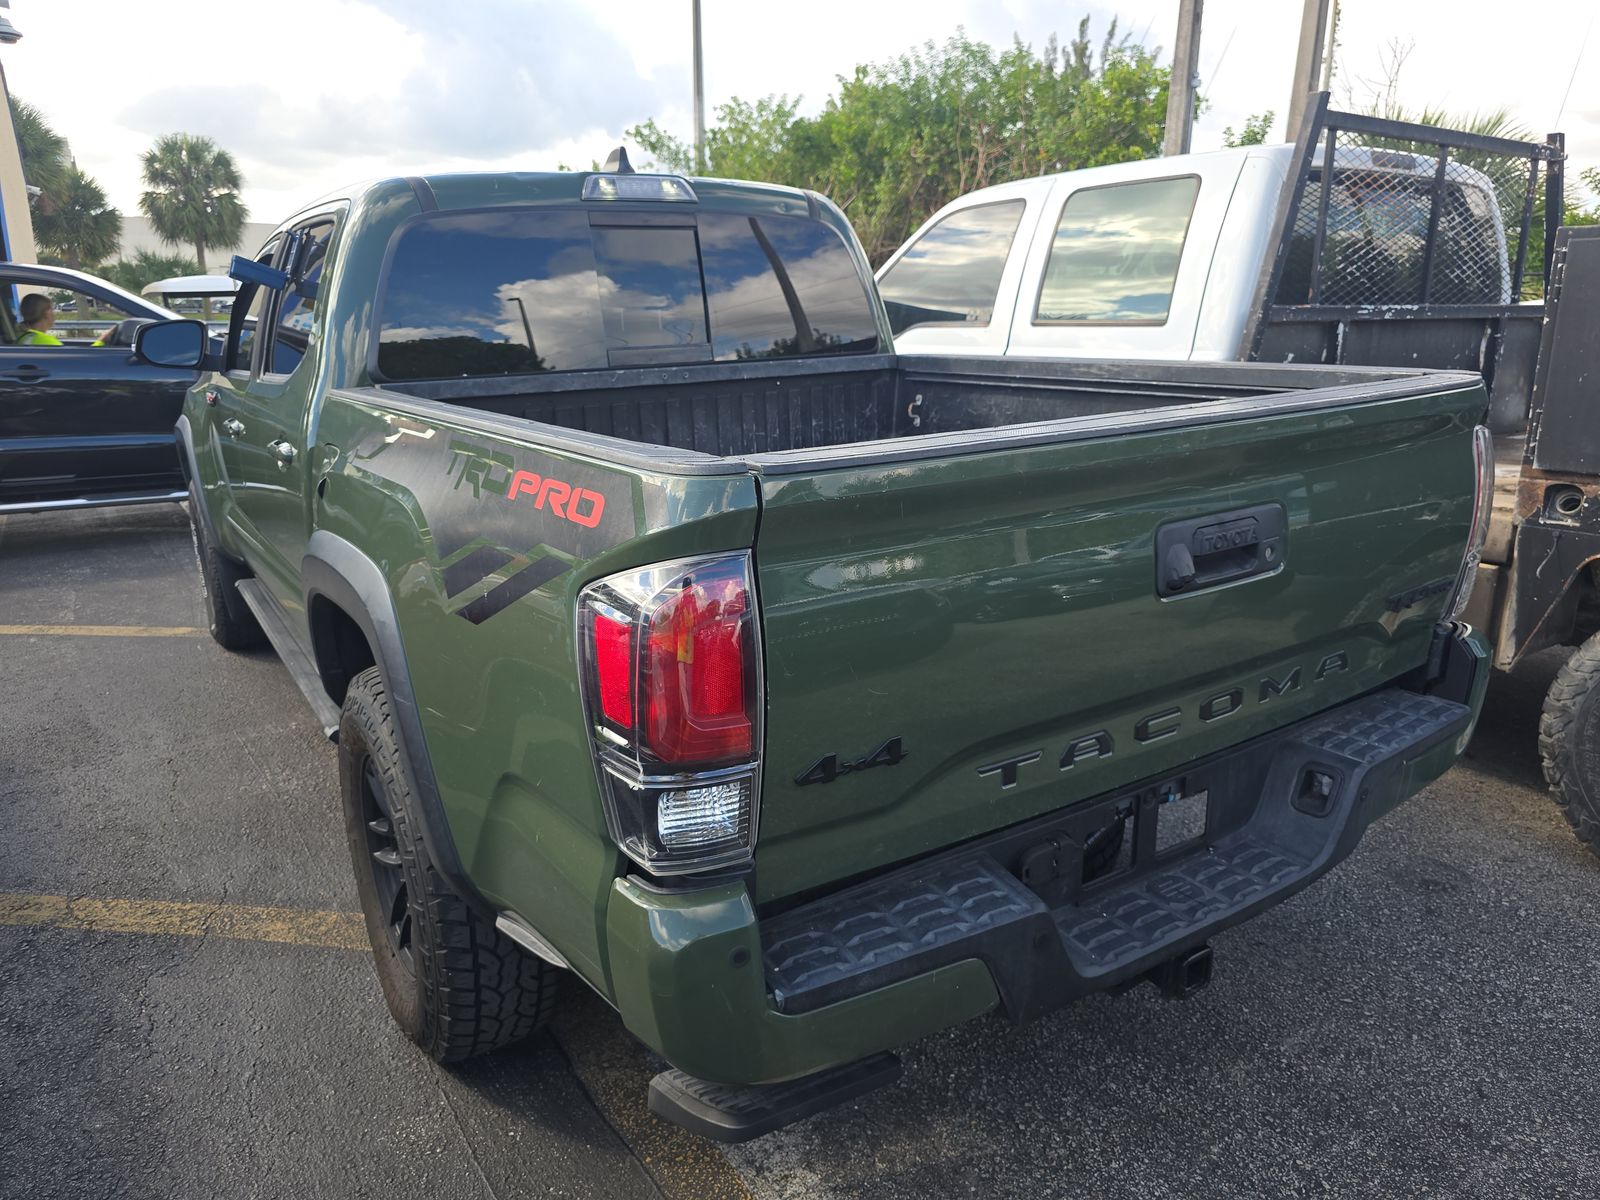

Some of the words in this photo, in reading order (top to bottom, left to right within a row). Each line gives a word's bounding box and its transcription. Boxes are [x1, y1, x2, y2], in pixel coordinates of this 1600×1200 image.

[447, 440, 514, 499] TRD
[507, 470, 606, 529] PRO
[1203, 524, 1258, 551] TOYOTA
[978, 650, 1350, 791] TACOMA
